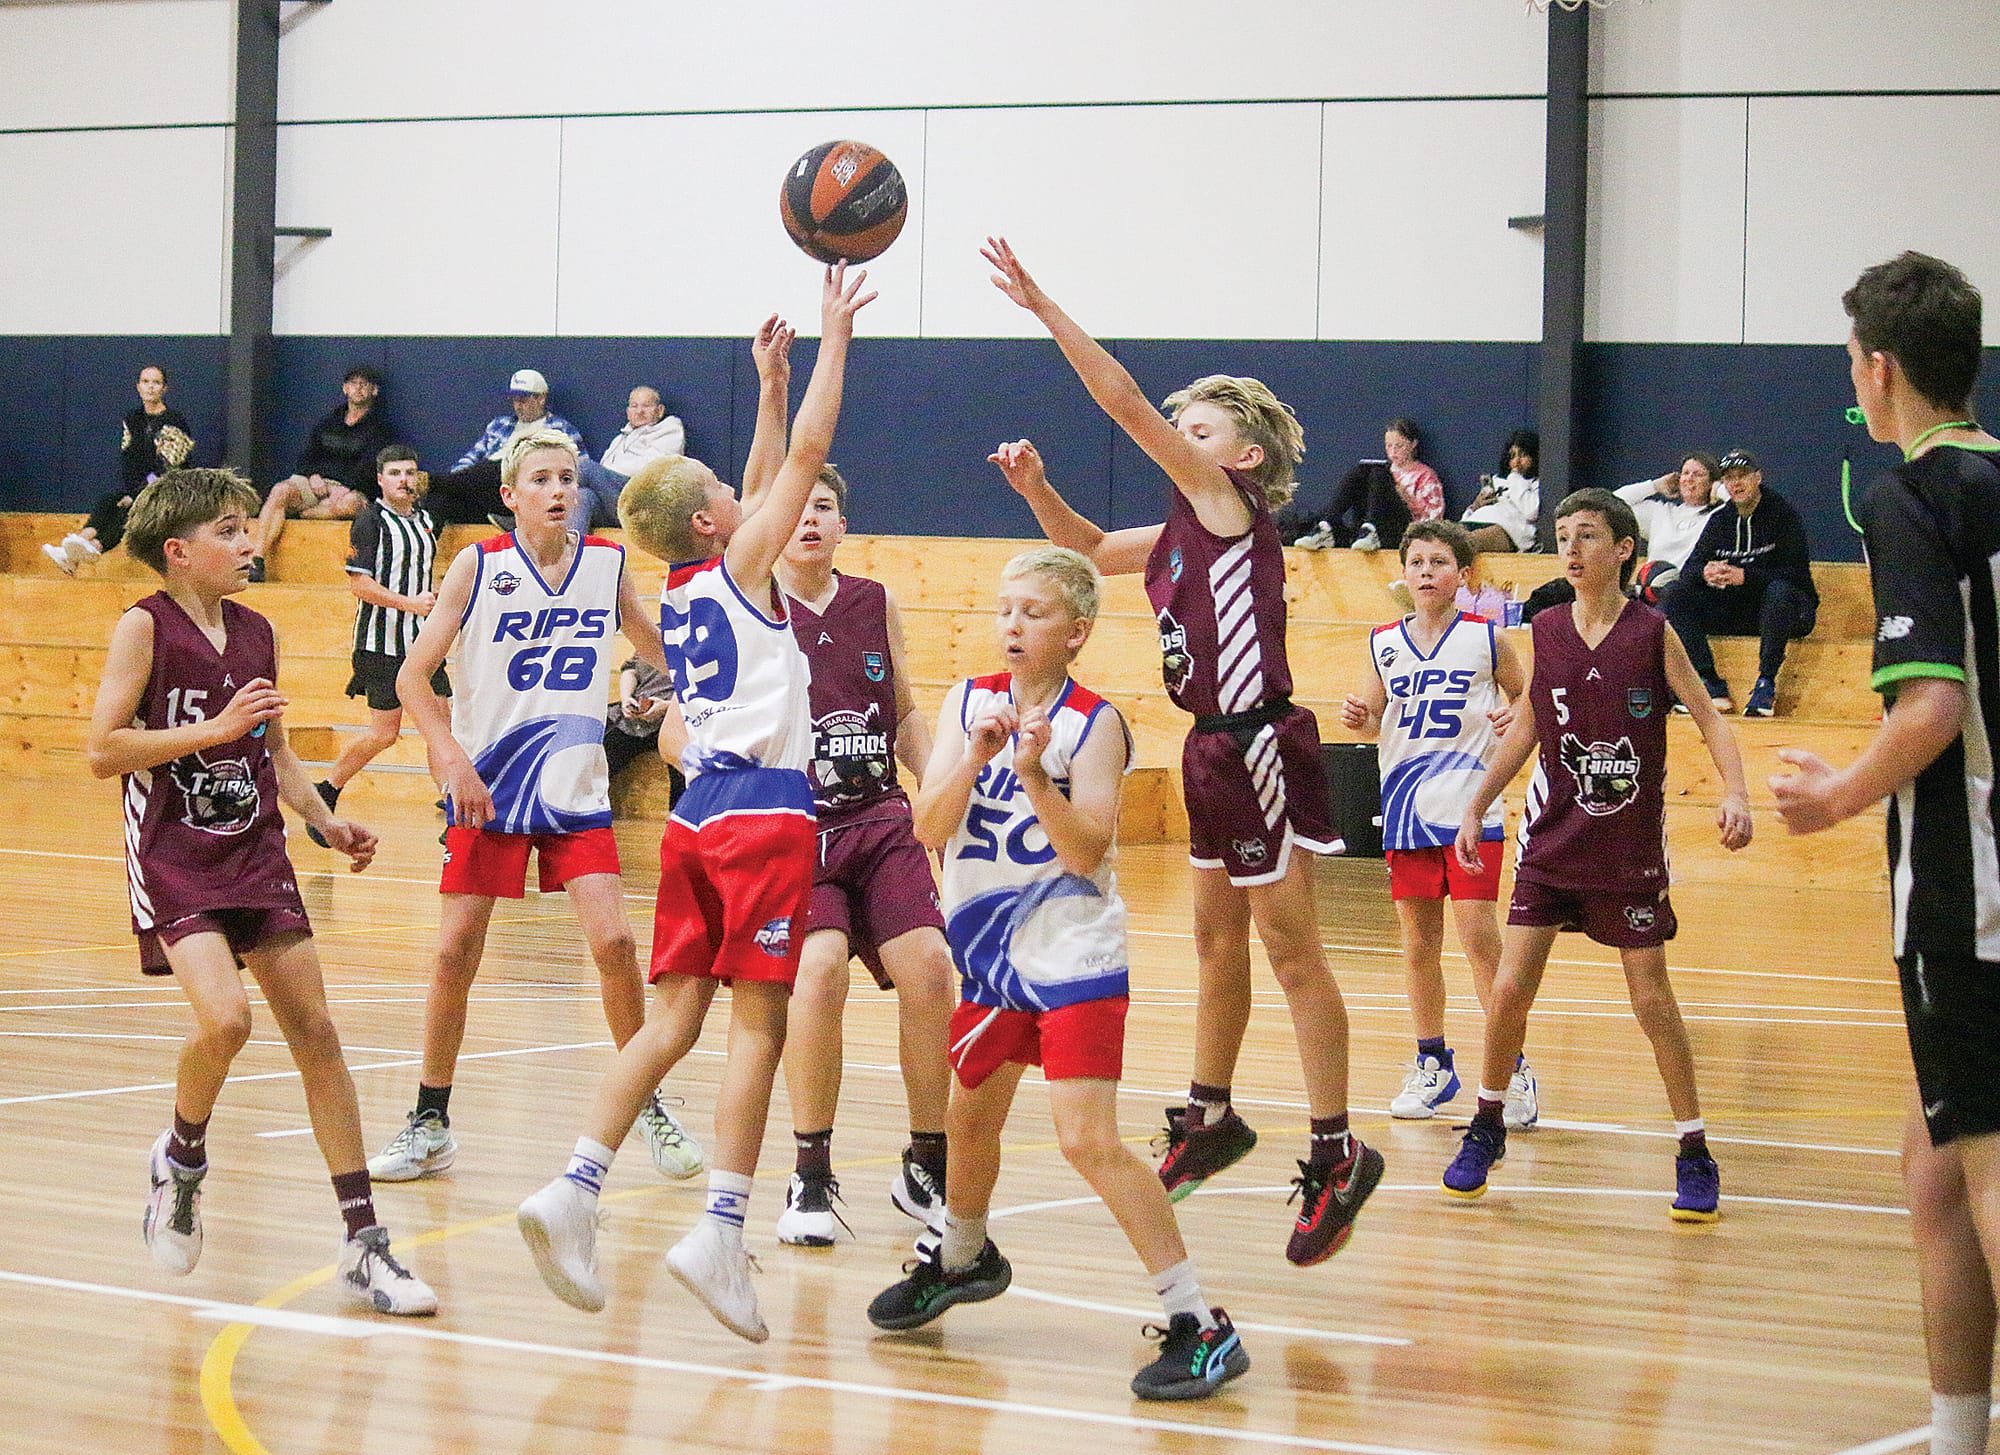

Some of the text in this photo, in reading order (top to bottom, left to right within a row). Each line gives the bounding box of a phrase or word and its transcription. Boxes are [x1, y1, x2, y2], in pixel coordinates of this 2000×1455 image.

[489, 577, 521, 590] RIPS
[492, 607, 610, 643] RIPS
[507, 645, 597, 692] 68
[1389, 669, 1477, 699] RIPS
[166, 687, 207, 728] 15
[1397, 699, 1467, 739] 45
[1552, 687, 1570, 725] 5
